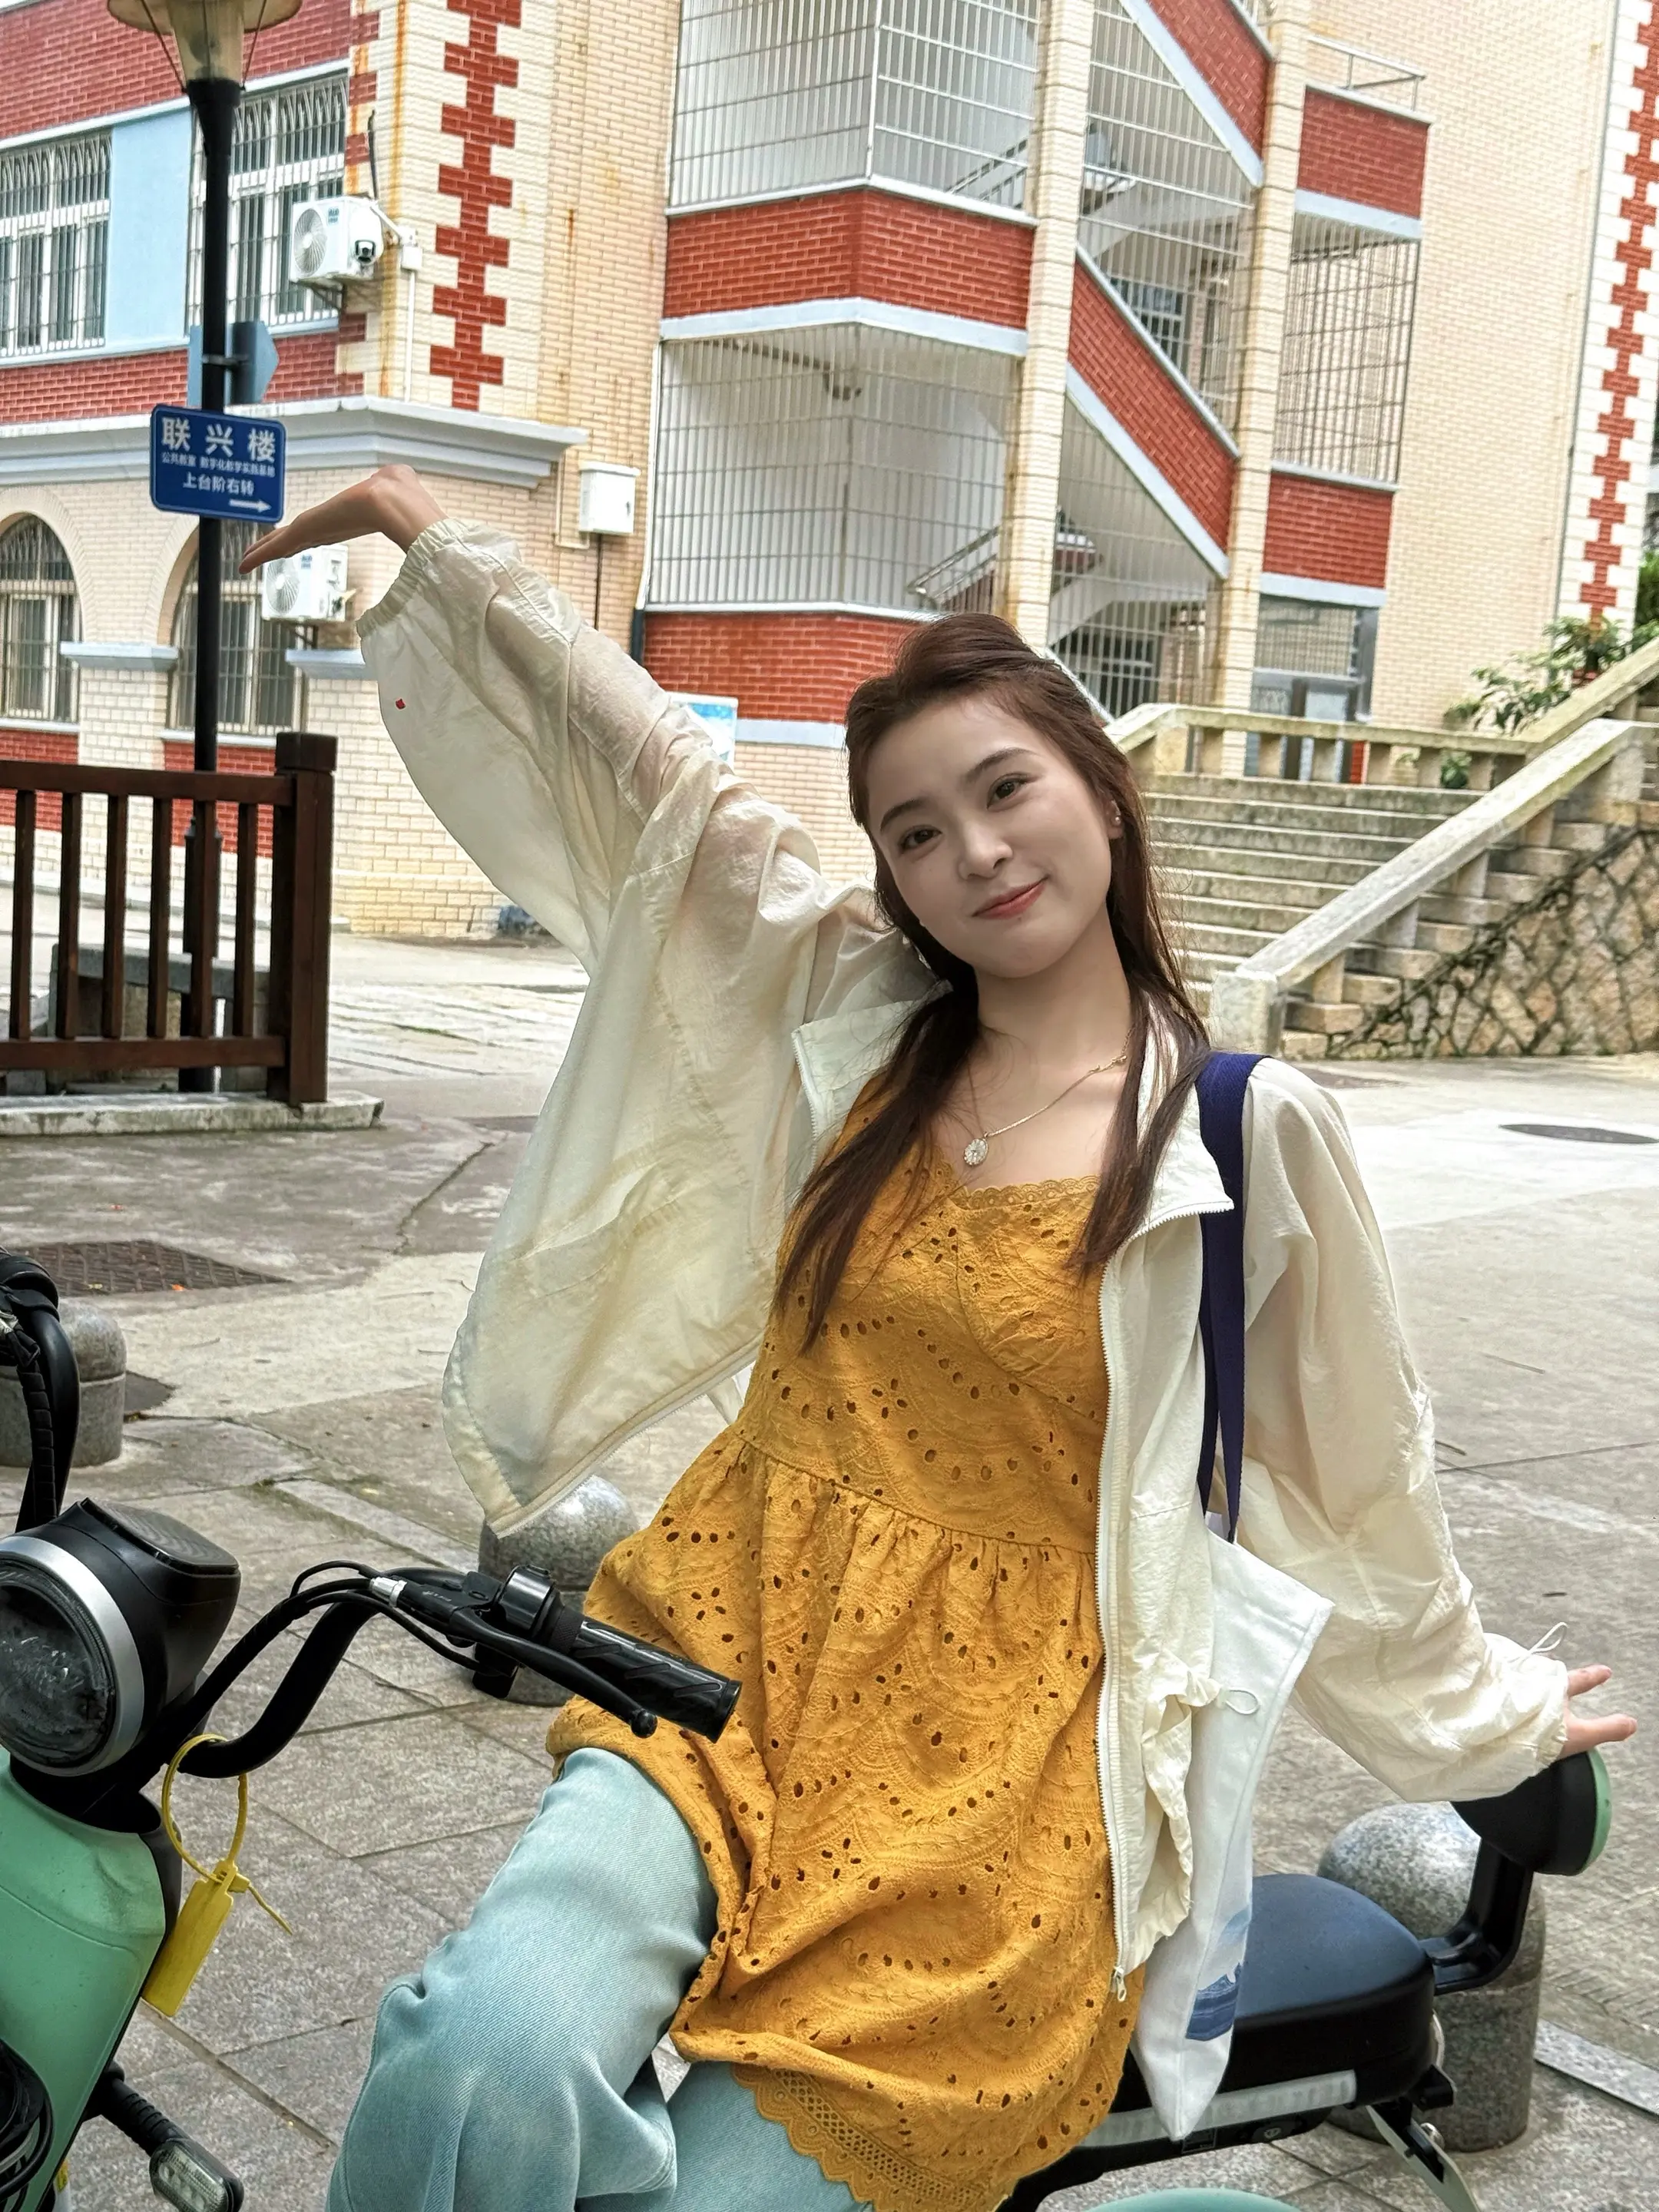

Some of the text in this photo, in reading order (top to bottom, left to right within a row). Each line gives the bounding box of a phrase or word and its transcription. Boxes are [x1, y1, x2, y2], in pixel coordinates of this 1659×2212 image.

[161, 417, 276, 462] 联兴楼
[183, 472, 255, 496] 上台阶右转
